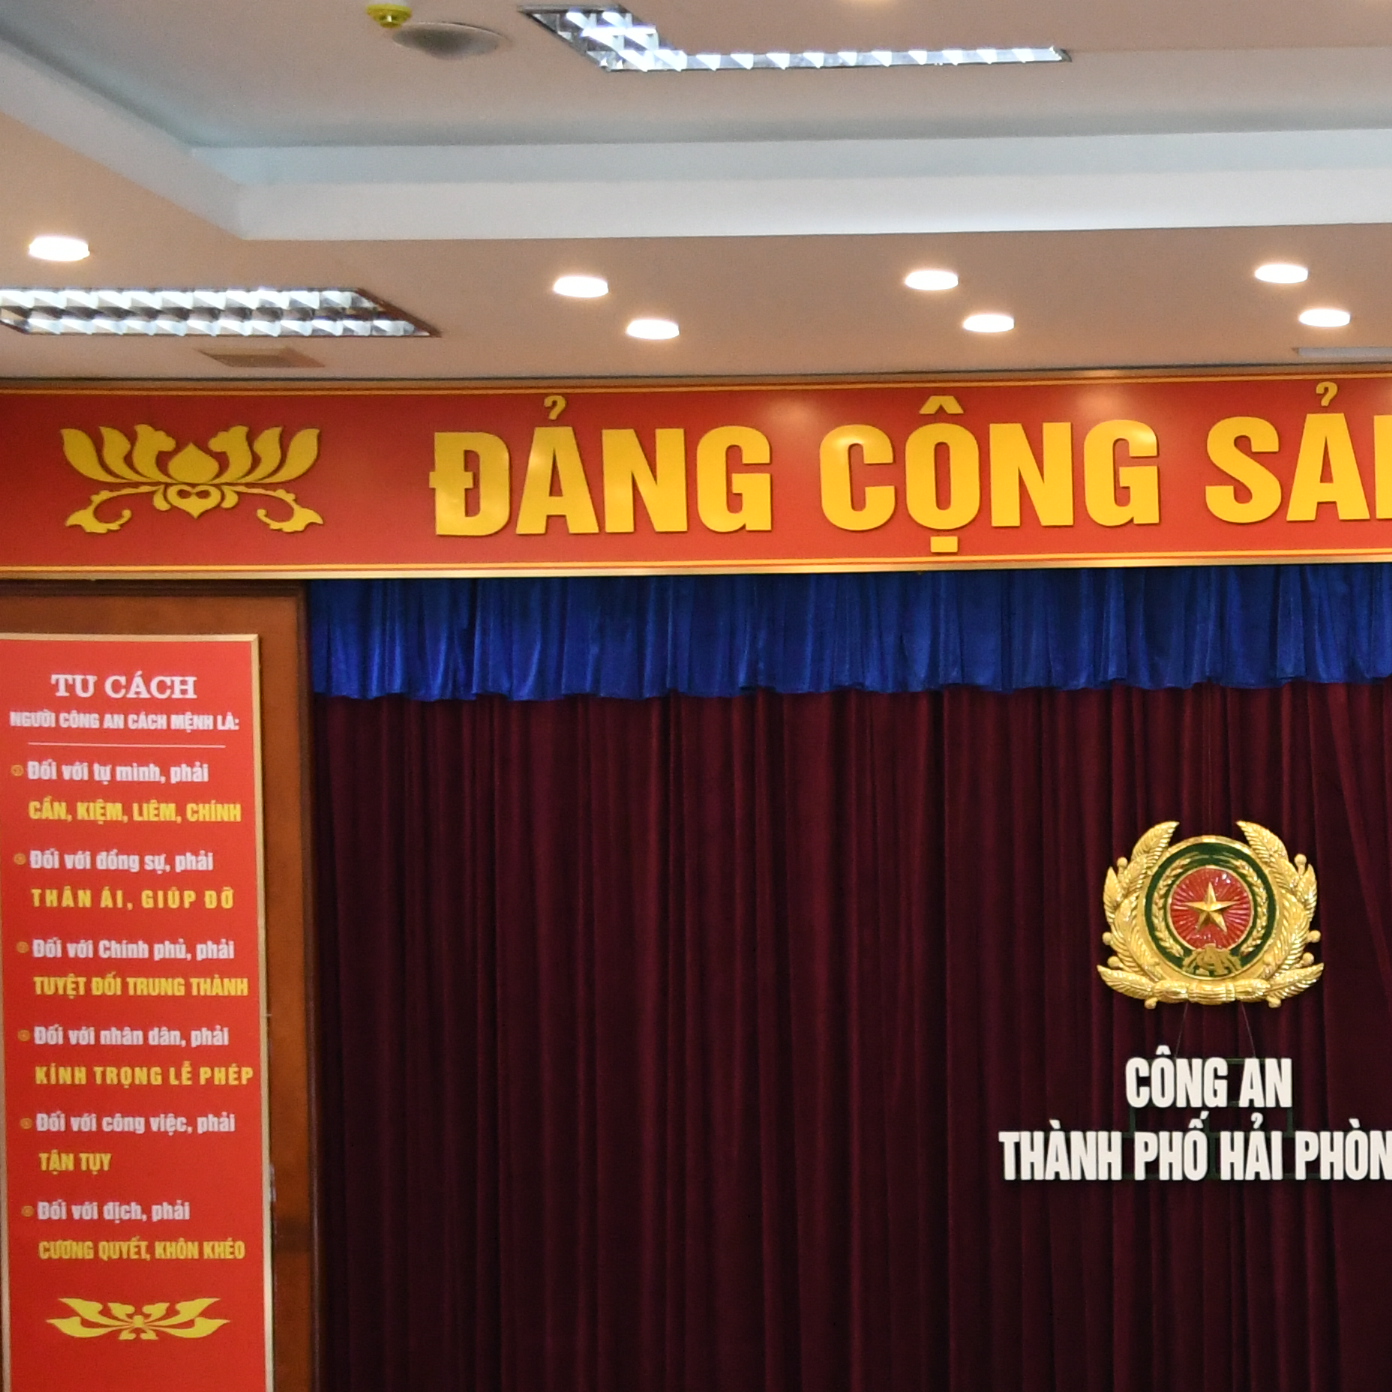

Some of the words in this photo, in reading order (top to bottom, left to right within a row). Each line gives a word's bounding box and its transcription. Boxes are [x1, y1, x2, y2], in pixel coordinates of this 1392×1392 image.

[430, 394, 774, 538] ĐẢNG
[819, 395, 1160, 553] CỘNG
[31, 885, 92, 908] THÂN
[99, 886, 133, 911] ÁI,
[141, 886, 197, 909] GIÚP
[33, 973, 87, 999] TUYỆT
[90, 971, 122, 996] ĐỐI
[125, 977, 186, 997] TRUNG
[189, 973, 249, 997] THÀNH
[35, 1062, 87, 1085] KÍNH
[93, 1066, 163, 1089] TRỌNG
[199, 1062, 254, 1086] PHÉP
[1125, 1044, 1229, 1109] CÔNG
[1238, 1057, 1293, 1108] AN
[998, 1119, 1123, 1181] THÀNH
[1133, 1110, 1210, 1182] PHỐ
[1219, 1111, 1284, 1181] HẢI
[38, 1149, 75, 1175] TẬN
[98, 1236, 151, 1262] QUYẾT,
[154, 1237, 200, 1260] KHÔN
[202, 1237, 246, 1260] KHÉO
